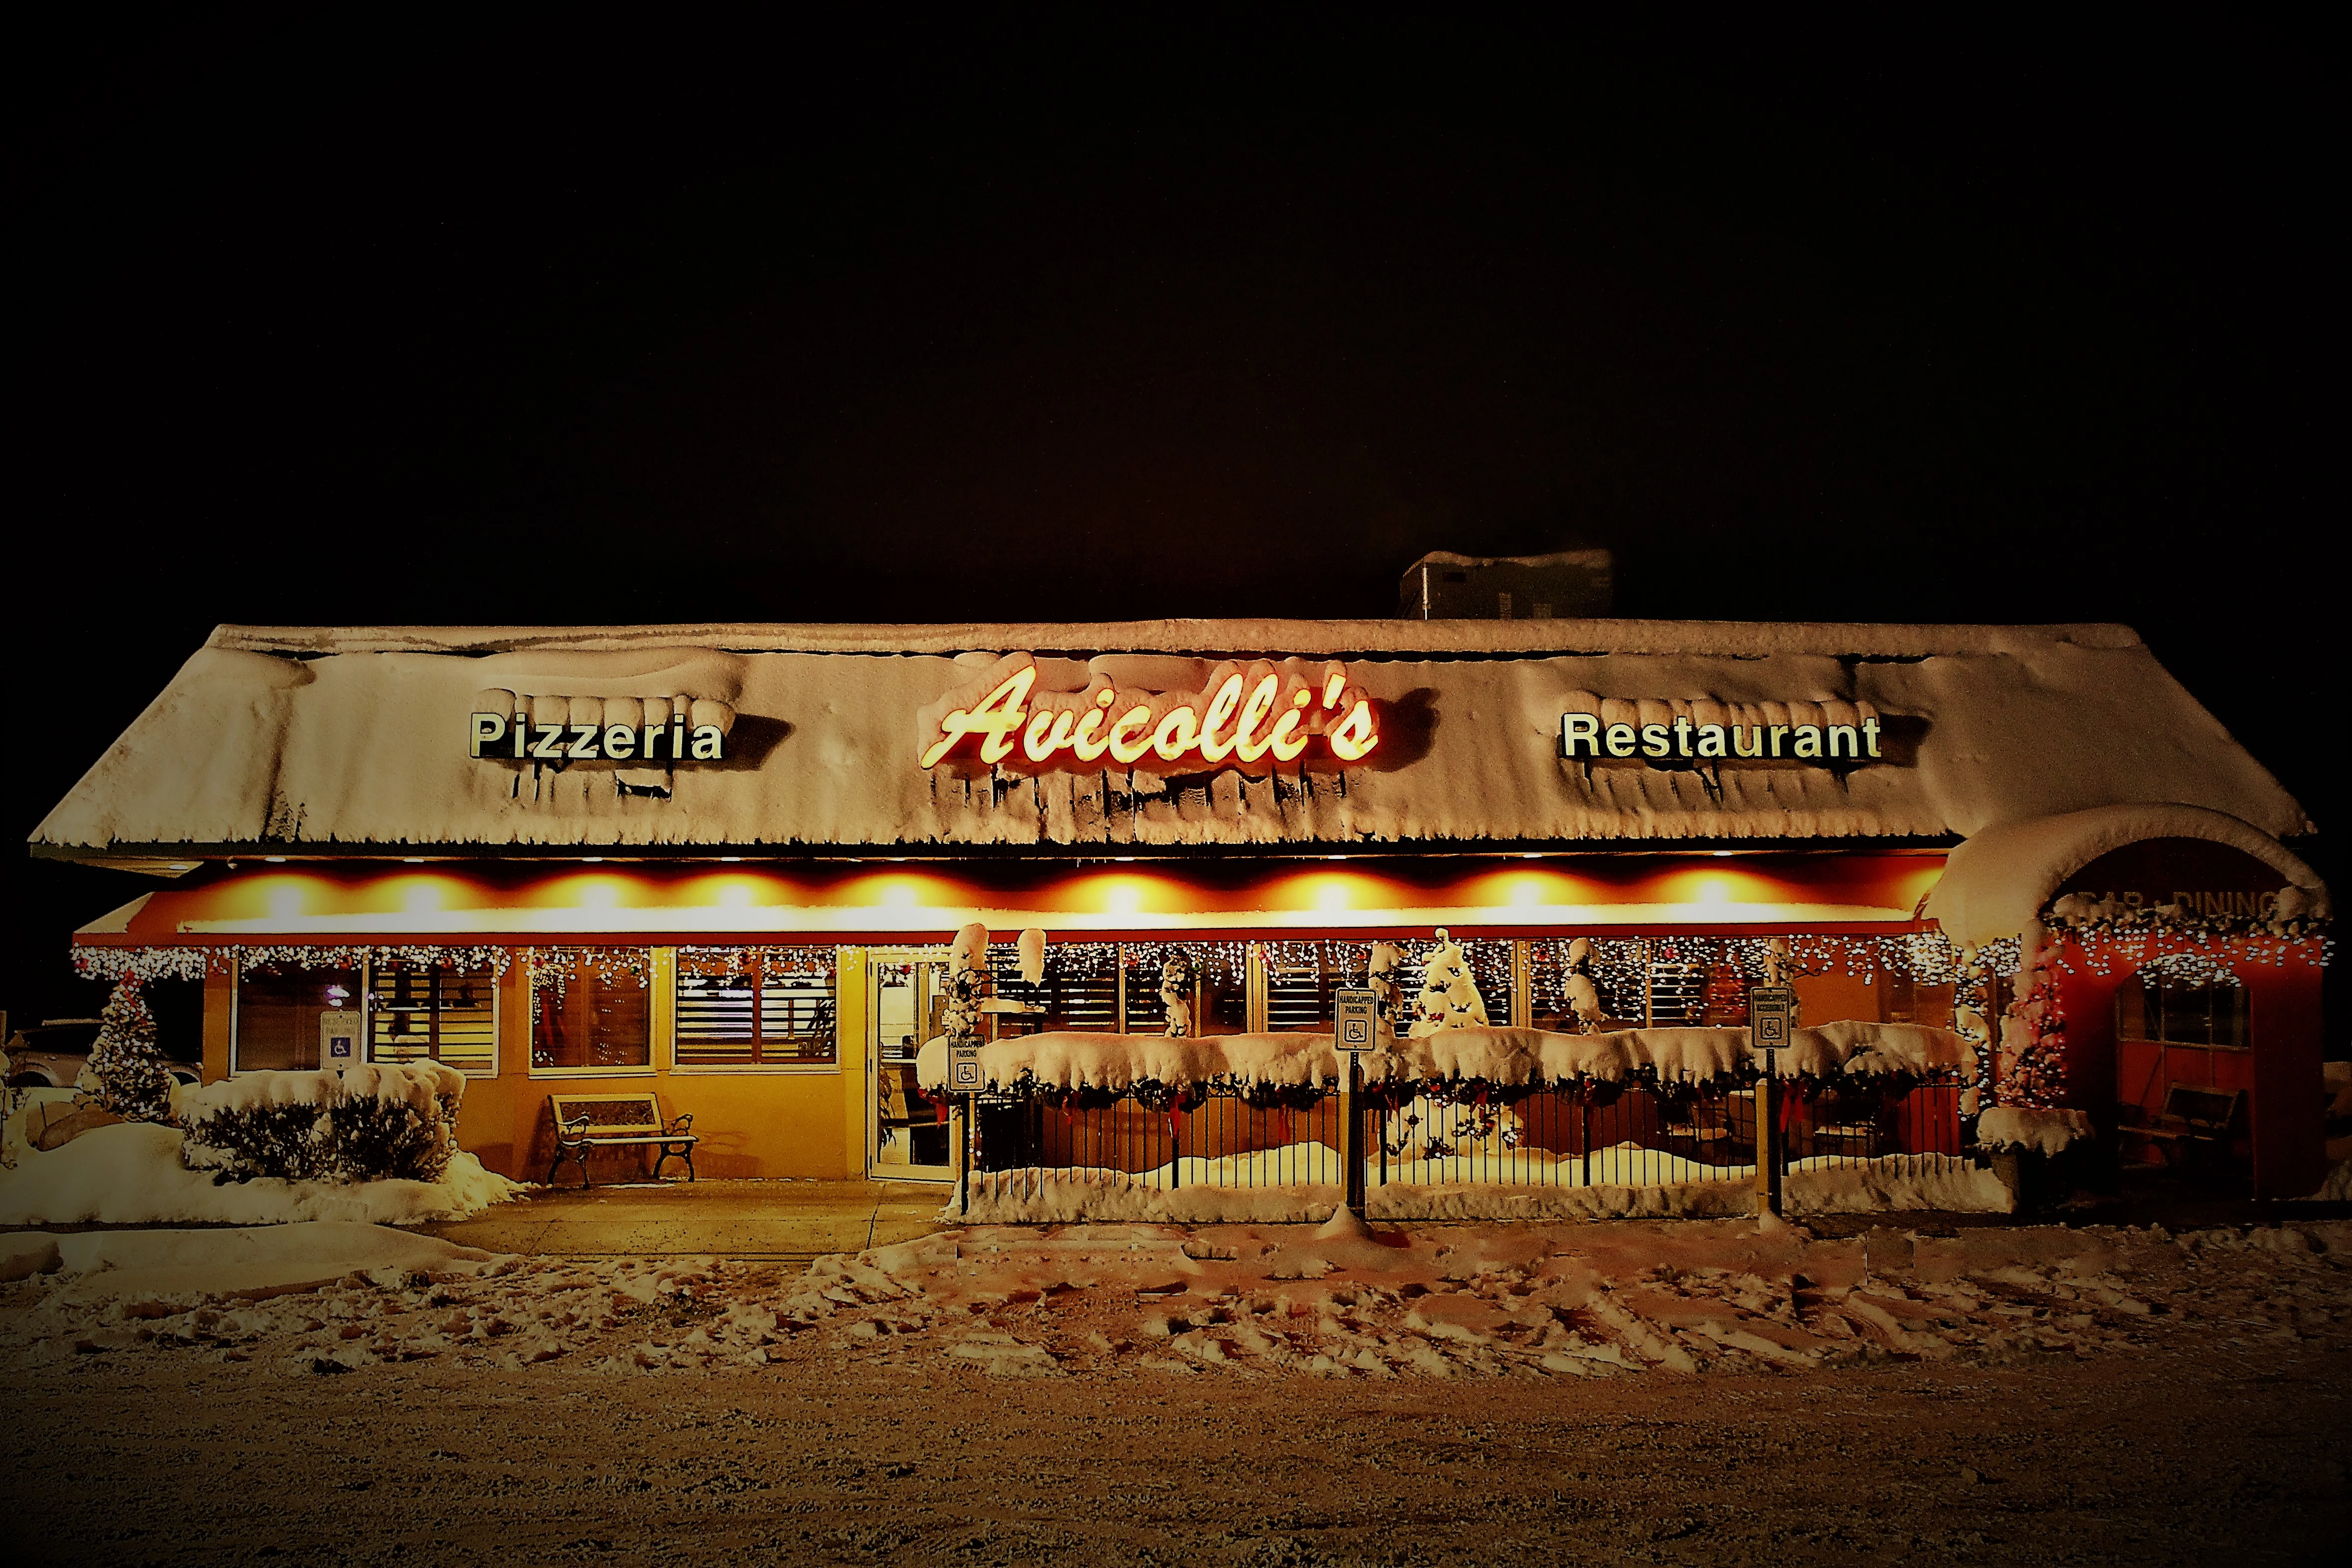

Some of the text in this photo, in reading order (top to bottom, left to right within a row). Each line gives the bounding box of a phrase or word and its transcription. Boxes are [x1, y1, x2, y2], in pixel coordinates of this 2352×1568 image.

[470, 712, 723, 760] Pizzeria
[920, 666, 1380, 769] Avicolli's
[1562, 713, 1882, 758] Restaurant
[1339, 995, 1373, 1004] HANDICAPPED
[1345, 1006, 1367, 1014] PARKING
